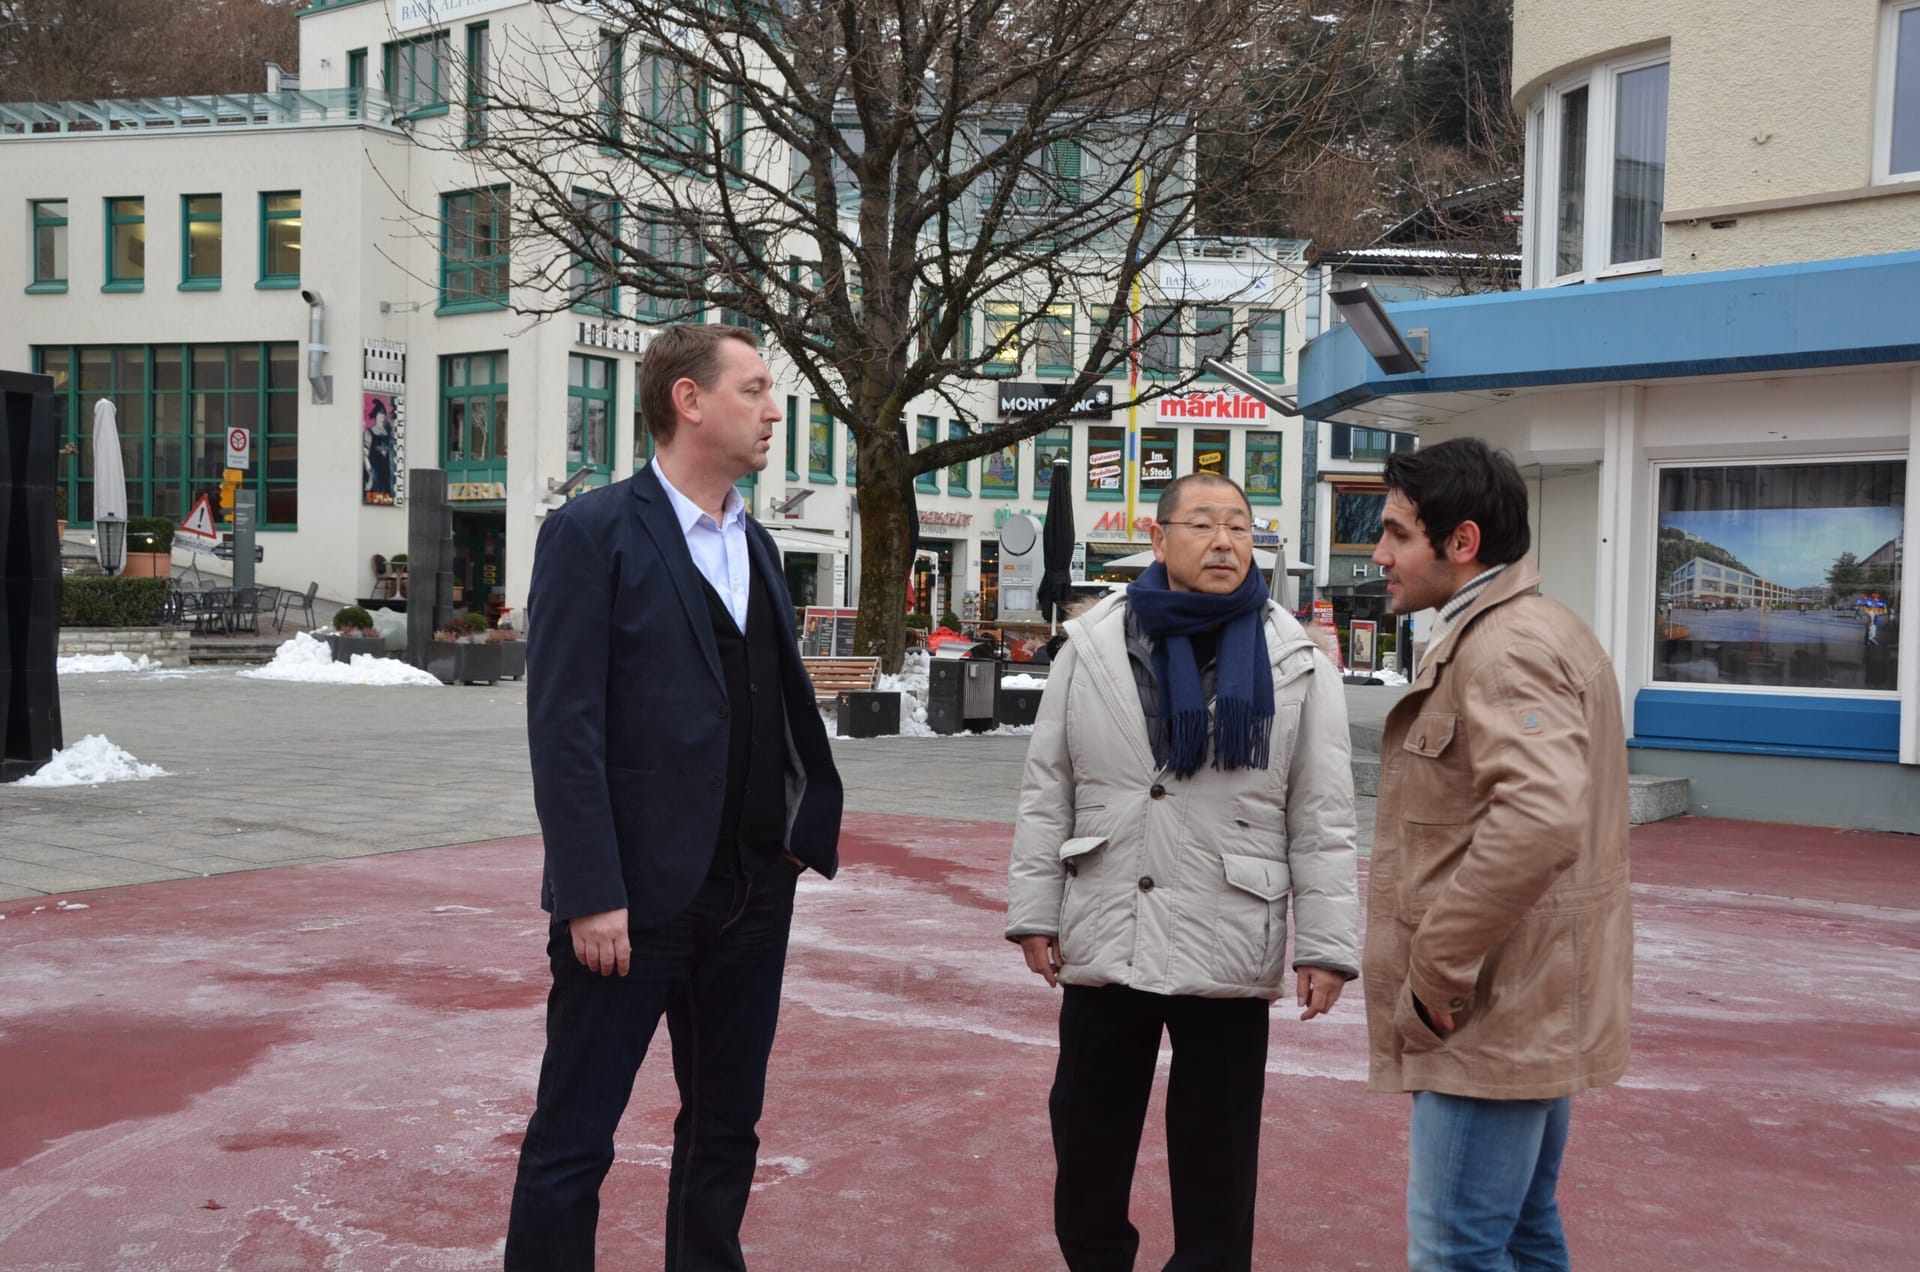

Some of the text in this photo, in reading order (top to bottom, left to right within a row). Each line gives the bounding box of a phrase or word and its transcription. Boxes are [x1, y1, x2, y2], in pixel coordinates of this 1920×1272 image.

[401, 0, 437, 21] BANK
[1166, 276, 1196, 287] BANK
[367, 338, 403, 353] RISTORANTE
[366, 380, 403, 394] ITALIANO
[1001, 397, 1095, 412] MONTNC
[394, 398, 405, 505] BRASSERIE
[1151, 451, 1163, 460] Im
[1142, 467, 1173, 477] 1. Stock
